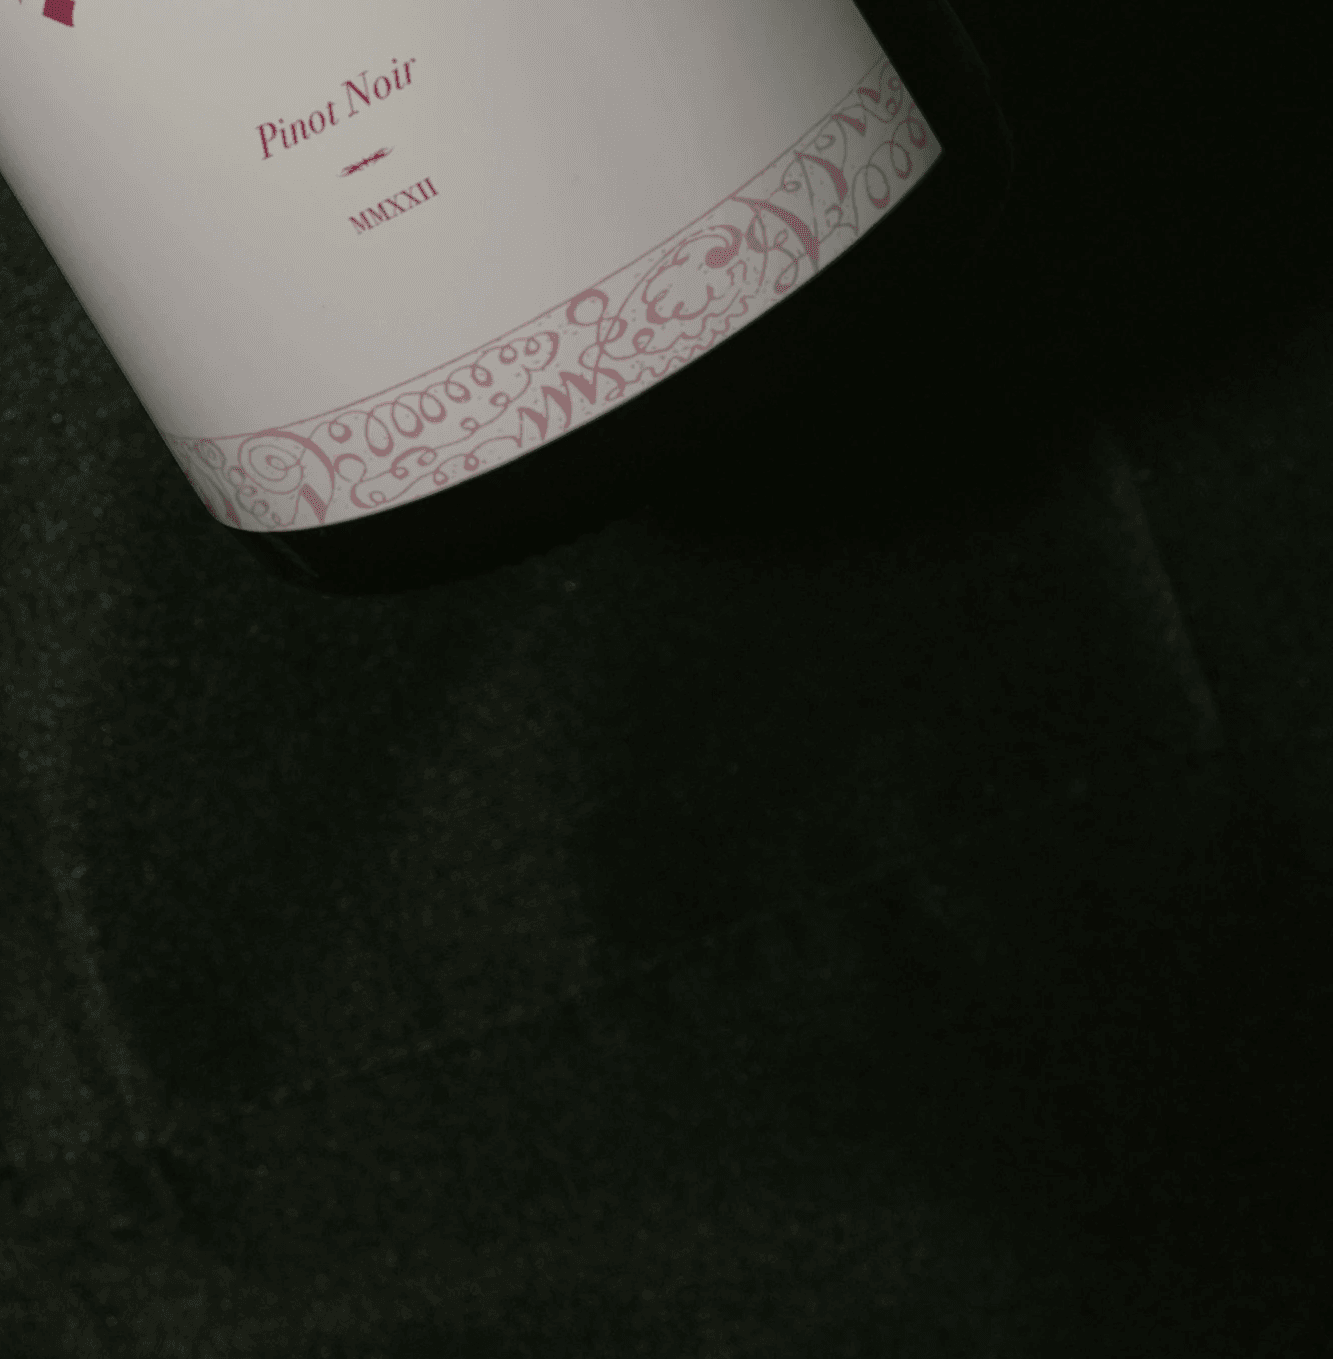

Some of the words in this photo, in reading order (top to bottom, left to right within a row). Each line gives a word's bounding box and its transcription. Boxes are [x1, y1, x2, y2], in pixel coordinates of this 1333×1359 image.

[255, 101, 340, 161] Pinot
[341, 57, 417, 118] Noir
[348, 176, 439, 236] MMXXII
